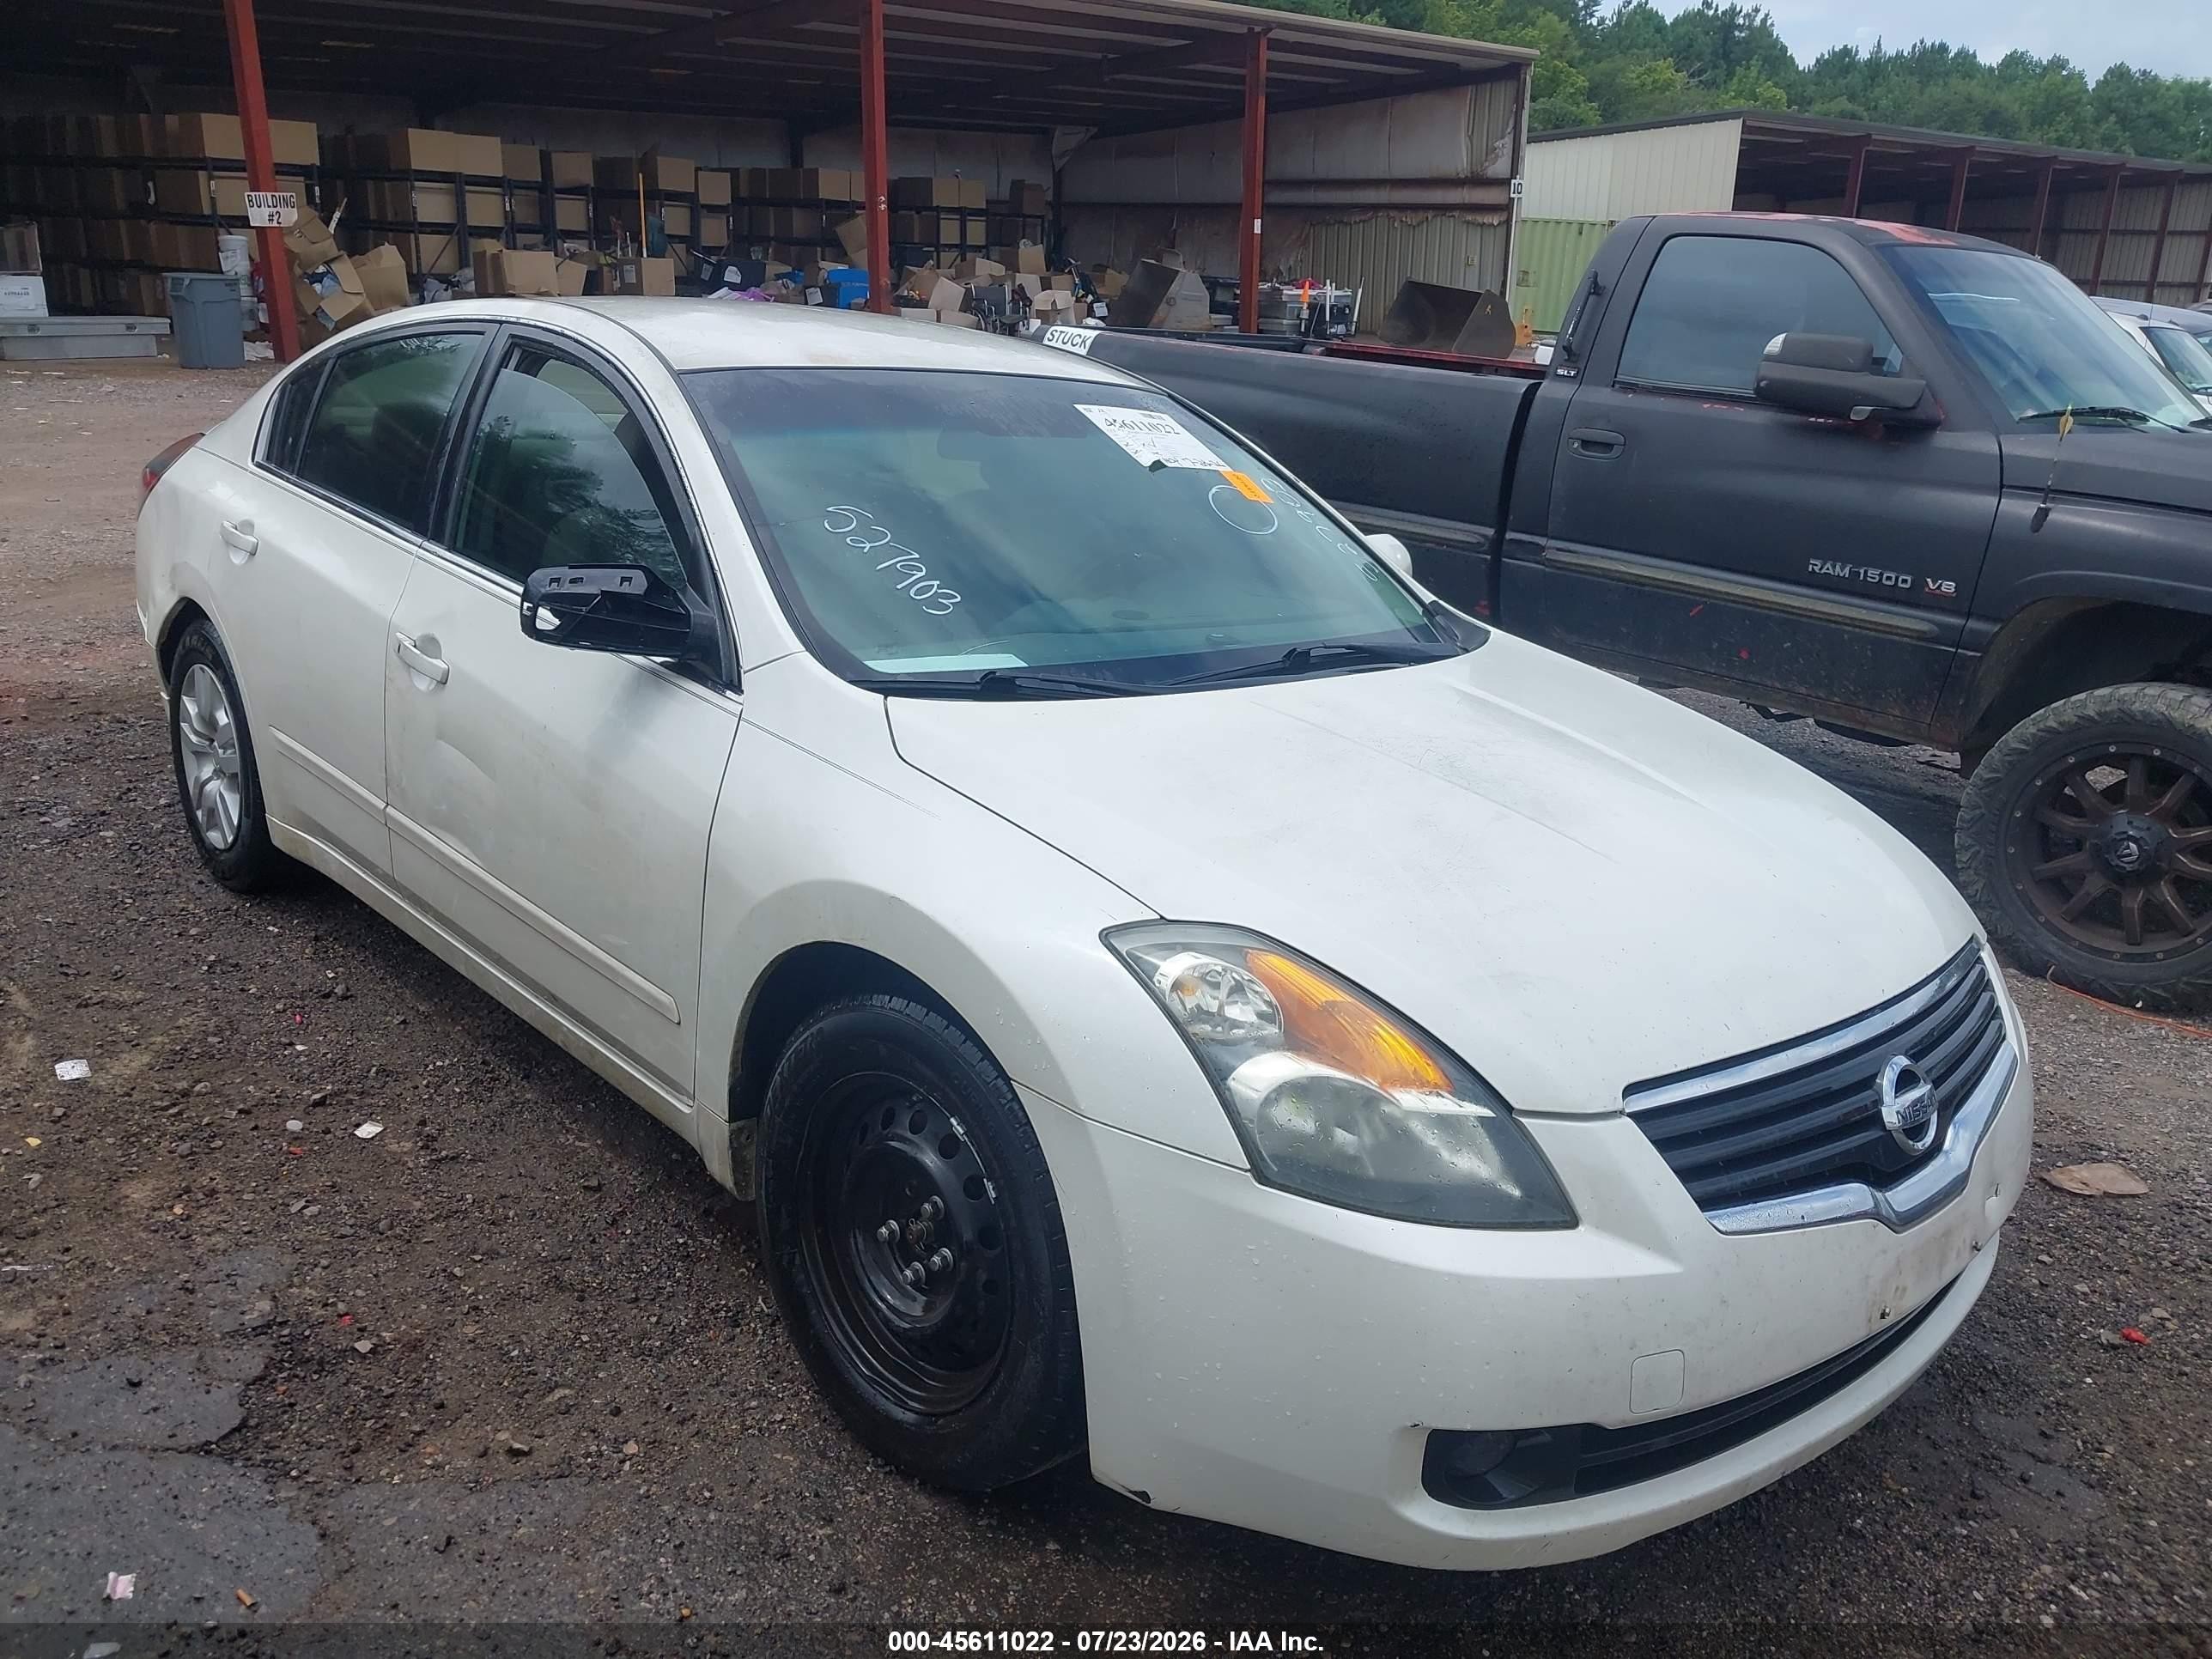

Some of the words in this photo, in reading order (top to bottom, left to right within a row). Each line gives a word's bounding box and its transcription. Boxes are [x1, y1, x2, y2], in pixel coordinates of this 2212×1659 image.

[1512, 182, 1522, 195] 10
[246, 194, 295, 209] BUILDING
[268, 210, 282, 225] #2
[1048, 329, 1091, 349] STUCK
[823, 505, 962, 615] 527903
[1808, 559, 1852, 579] RAM
[1852, 567, 1913, 589] 1500
[1925, 578, 1957, 594] V8
